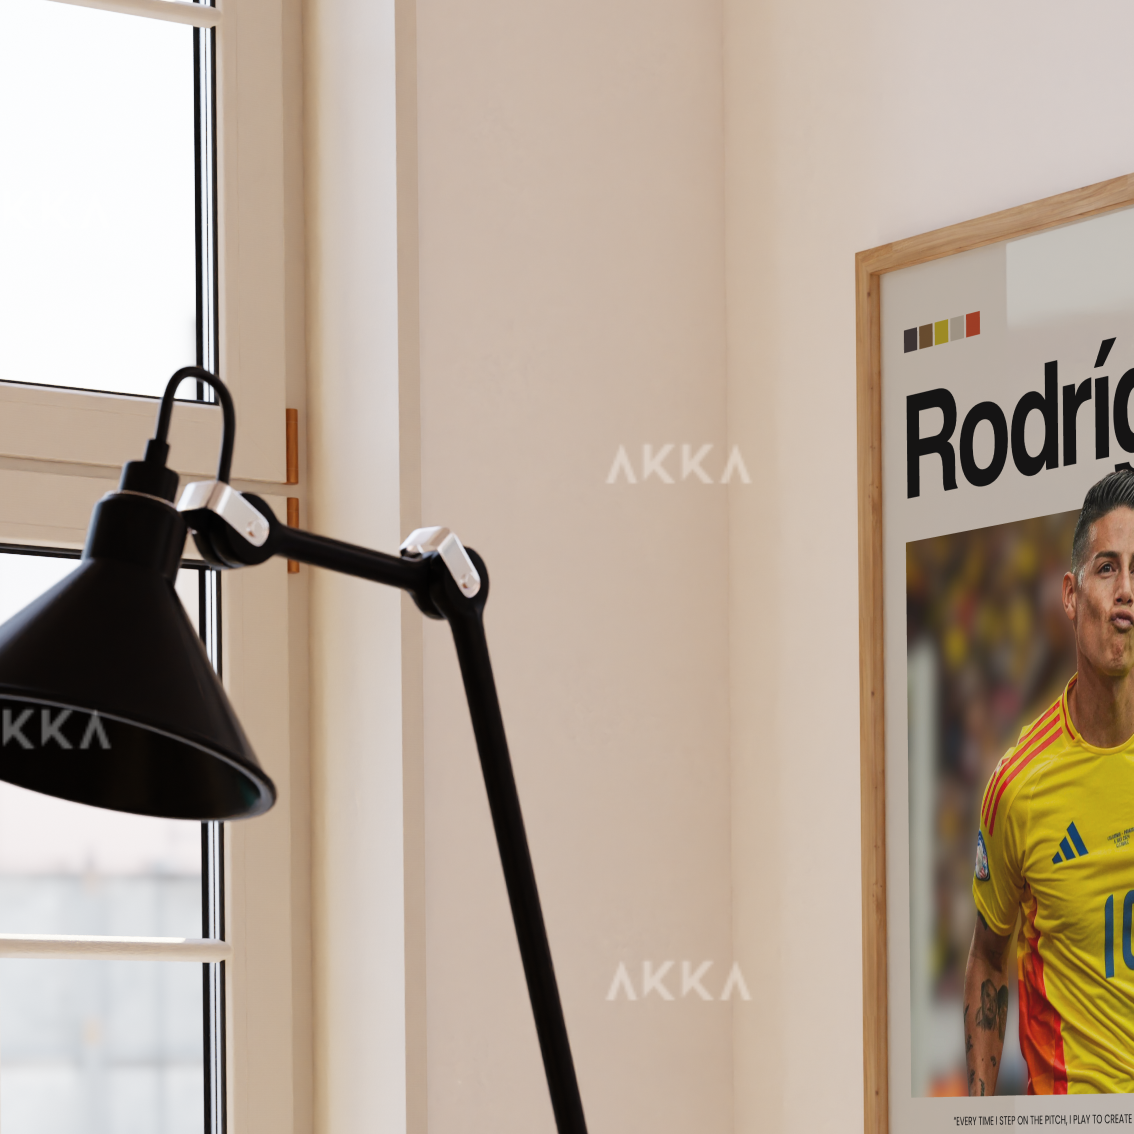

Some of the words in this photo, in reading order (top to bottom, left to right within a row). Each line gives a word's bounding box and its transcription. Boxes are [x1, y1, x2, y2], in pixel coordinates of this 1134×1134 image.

[979, 1115, 994, 1126] TIME
[999, 1115, 1015, 1125] STEP
[1017, 1115, 1028, 1125] ON
[1030, 1115, 1043, 1125] THE
[1044, 1114, 1067, 1126] PITCH,
[1073, 1114, 1090, 1124] PLAY
[1093, 1114, 1102, 1124] TO
[1104, 1113, 1132, 1124] CREATE
